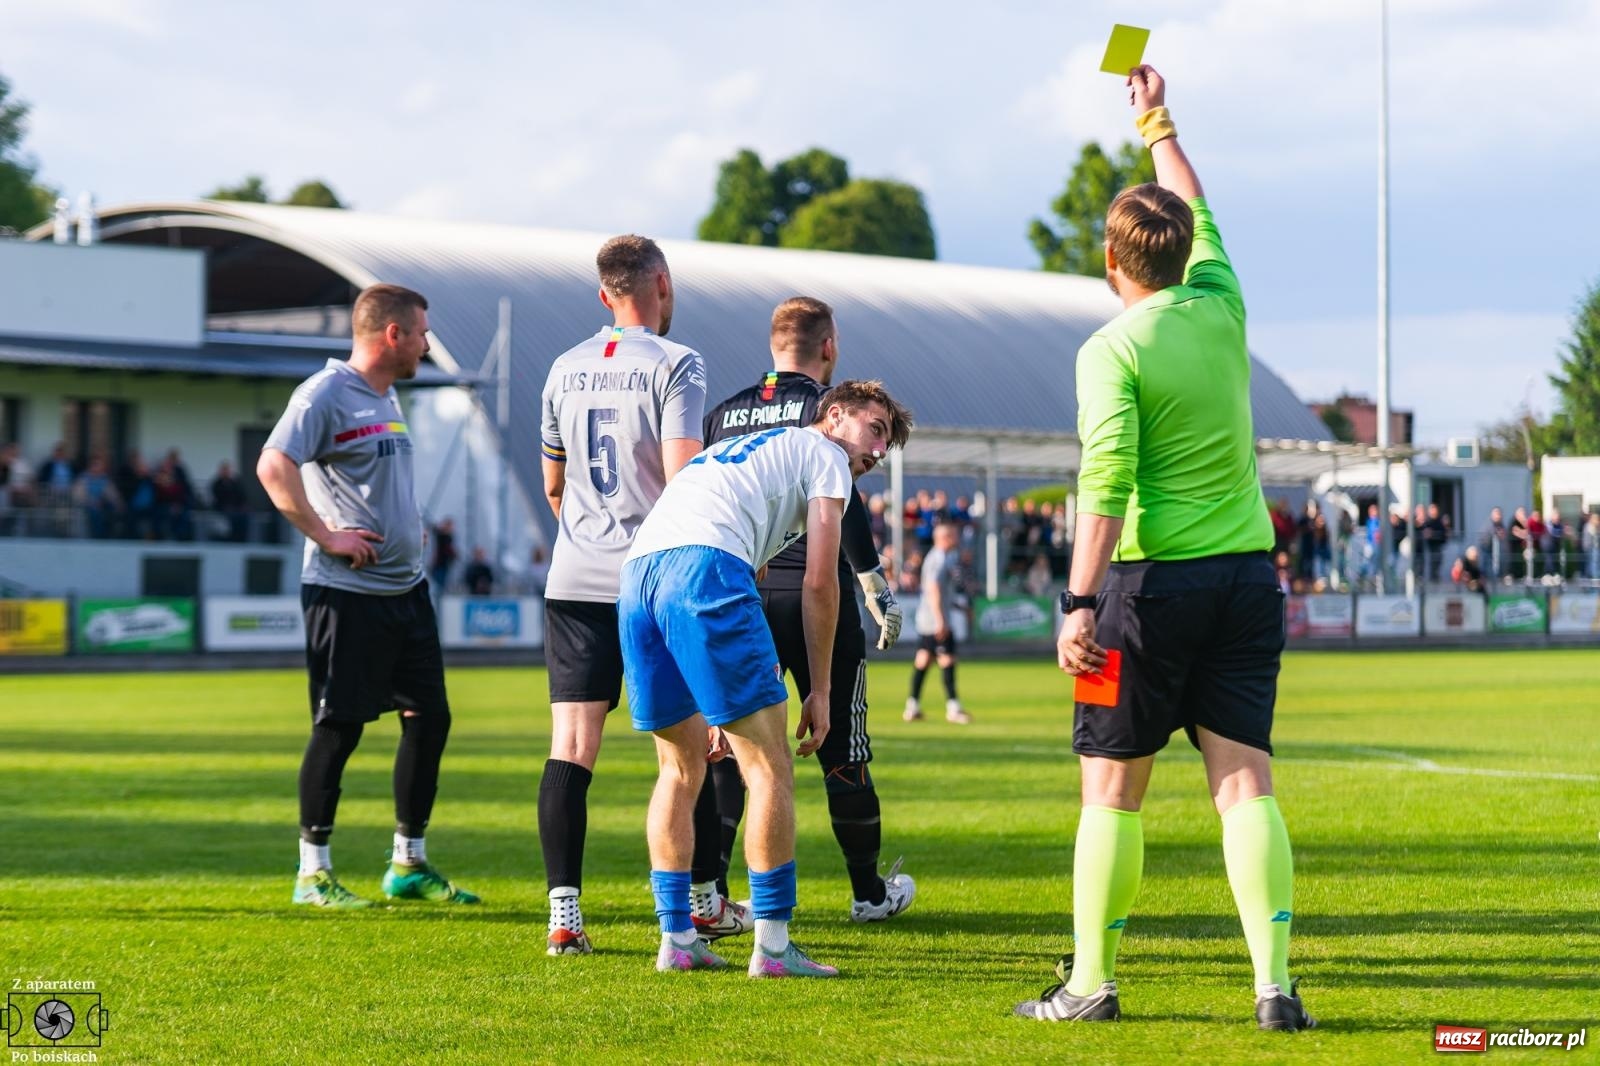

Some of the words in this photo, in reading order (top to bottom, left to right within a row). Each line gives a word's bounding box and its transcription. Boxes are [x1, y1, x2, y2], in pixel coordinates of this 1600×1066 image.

[562, 372, 587, 393] LKS
[722, 408, 749, 430] LKS
[749, 400, 804, 426] PAWŁÓW
[587, 408, 620, 497] 5
